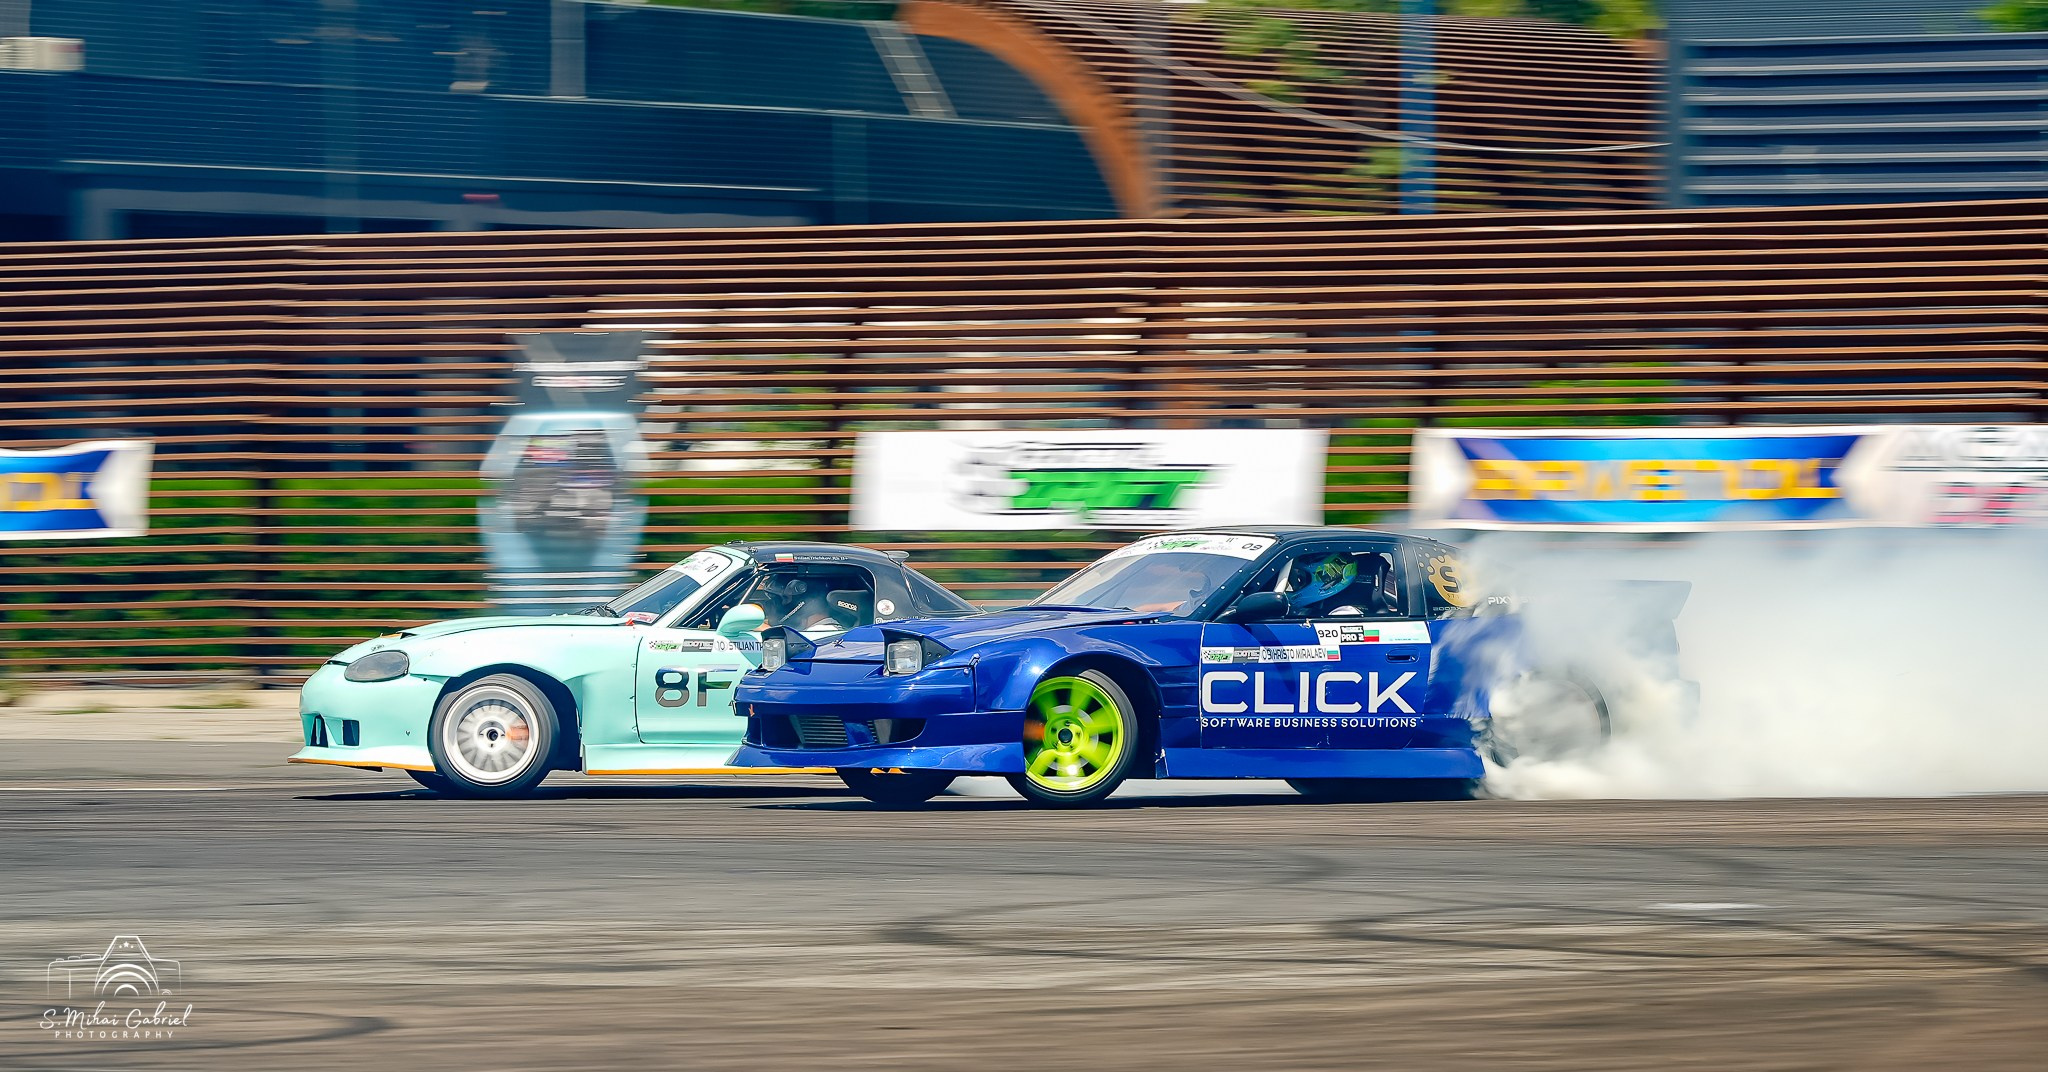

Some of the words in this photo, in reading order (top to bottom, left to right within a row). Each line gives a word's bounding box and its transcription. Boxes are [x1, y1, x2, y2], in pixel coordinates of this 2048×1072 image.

[1317, 629, 1338, 638] 920
[1341, 633, 1357, 641] PRO
[1358, 633, 1364, 641] 2
[716, 640, 726, 651] 10
[728, 641, 755, 651] STILIAN
[1295, 647, 1327, 660] MIRALAEV
[1201, 671, 1417, 714] CLICK
[1202, 718, 1270, 728] SOFTWARE
[1274, 718, 1337, 728] BUSINESS
[1341, 718, 1417, 728] SOLUTIONS
